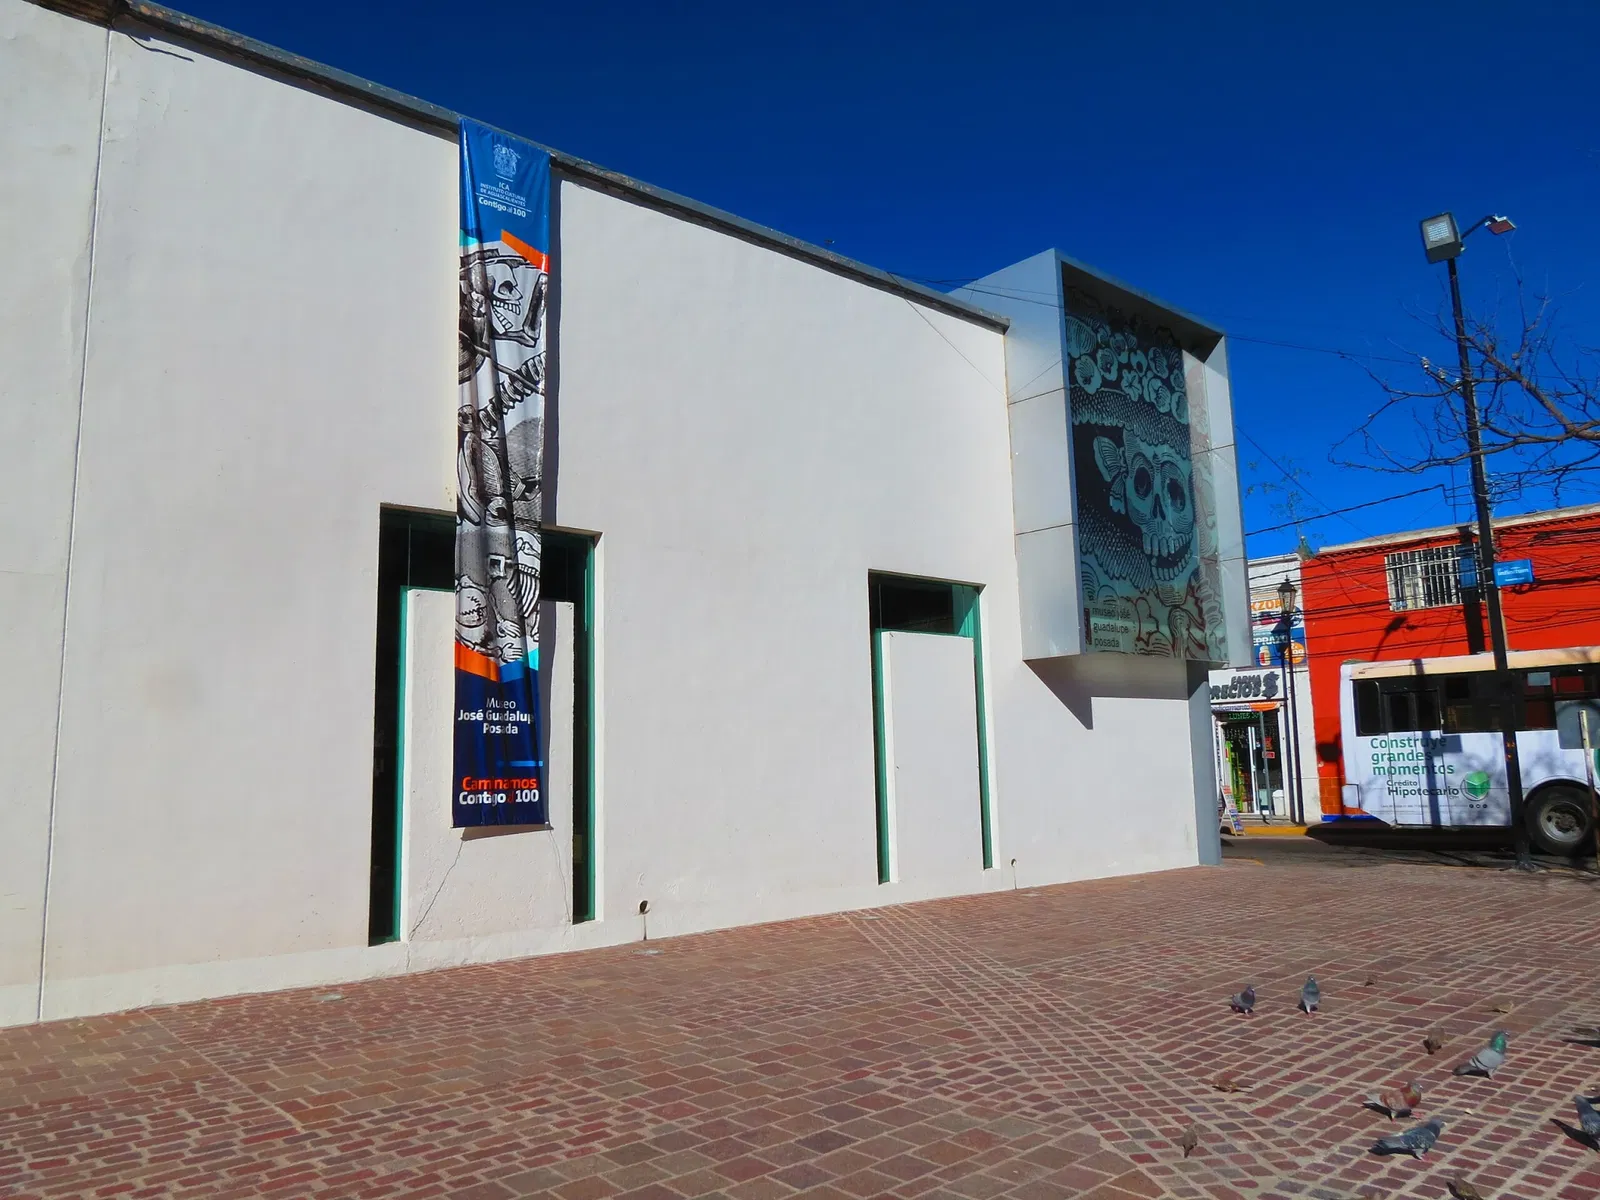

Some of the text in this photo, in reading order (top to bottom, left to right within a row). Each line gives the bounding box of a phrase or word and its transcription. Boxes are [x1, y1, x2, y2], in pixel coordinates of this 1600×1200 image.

[480, 182, 526, 202] INSTITUTO CULTURAL
[498, 182, 510, 190] ICA
[478, 196, 507, 212] Contigo
[513, 207, 526, 218] 100
[1092, 607, 1116, 617] museo
[1093, 622, 1129, 634] guadalupe
[1094, 637, 1120, 648] posada
[485, 697, 516, 709] Museo
[457, 709, 534, 725] José Guadalup
[483, 722, 518, 734] Posada
[1370, 737, 1447, 750] Construye
[1371, 750, 1434, 765] grandes
[1373, 763, 1455, 776] momentos
[462, 776, 537, 790] Caminamos
[458, 790, 507, 807] Contigo
[515, 789, 539, 803] 100
[1387, 785, 1460, 798] Hipotecario
